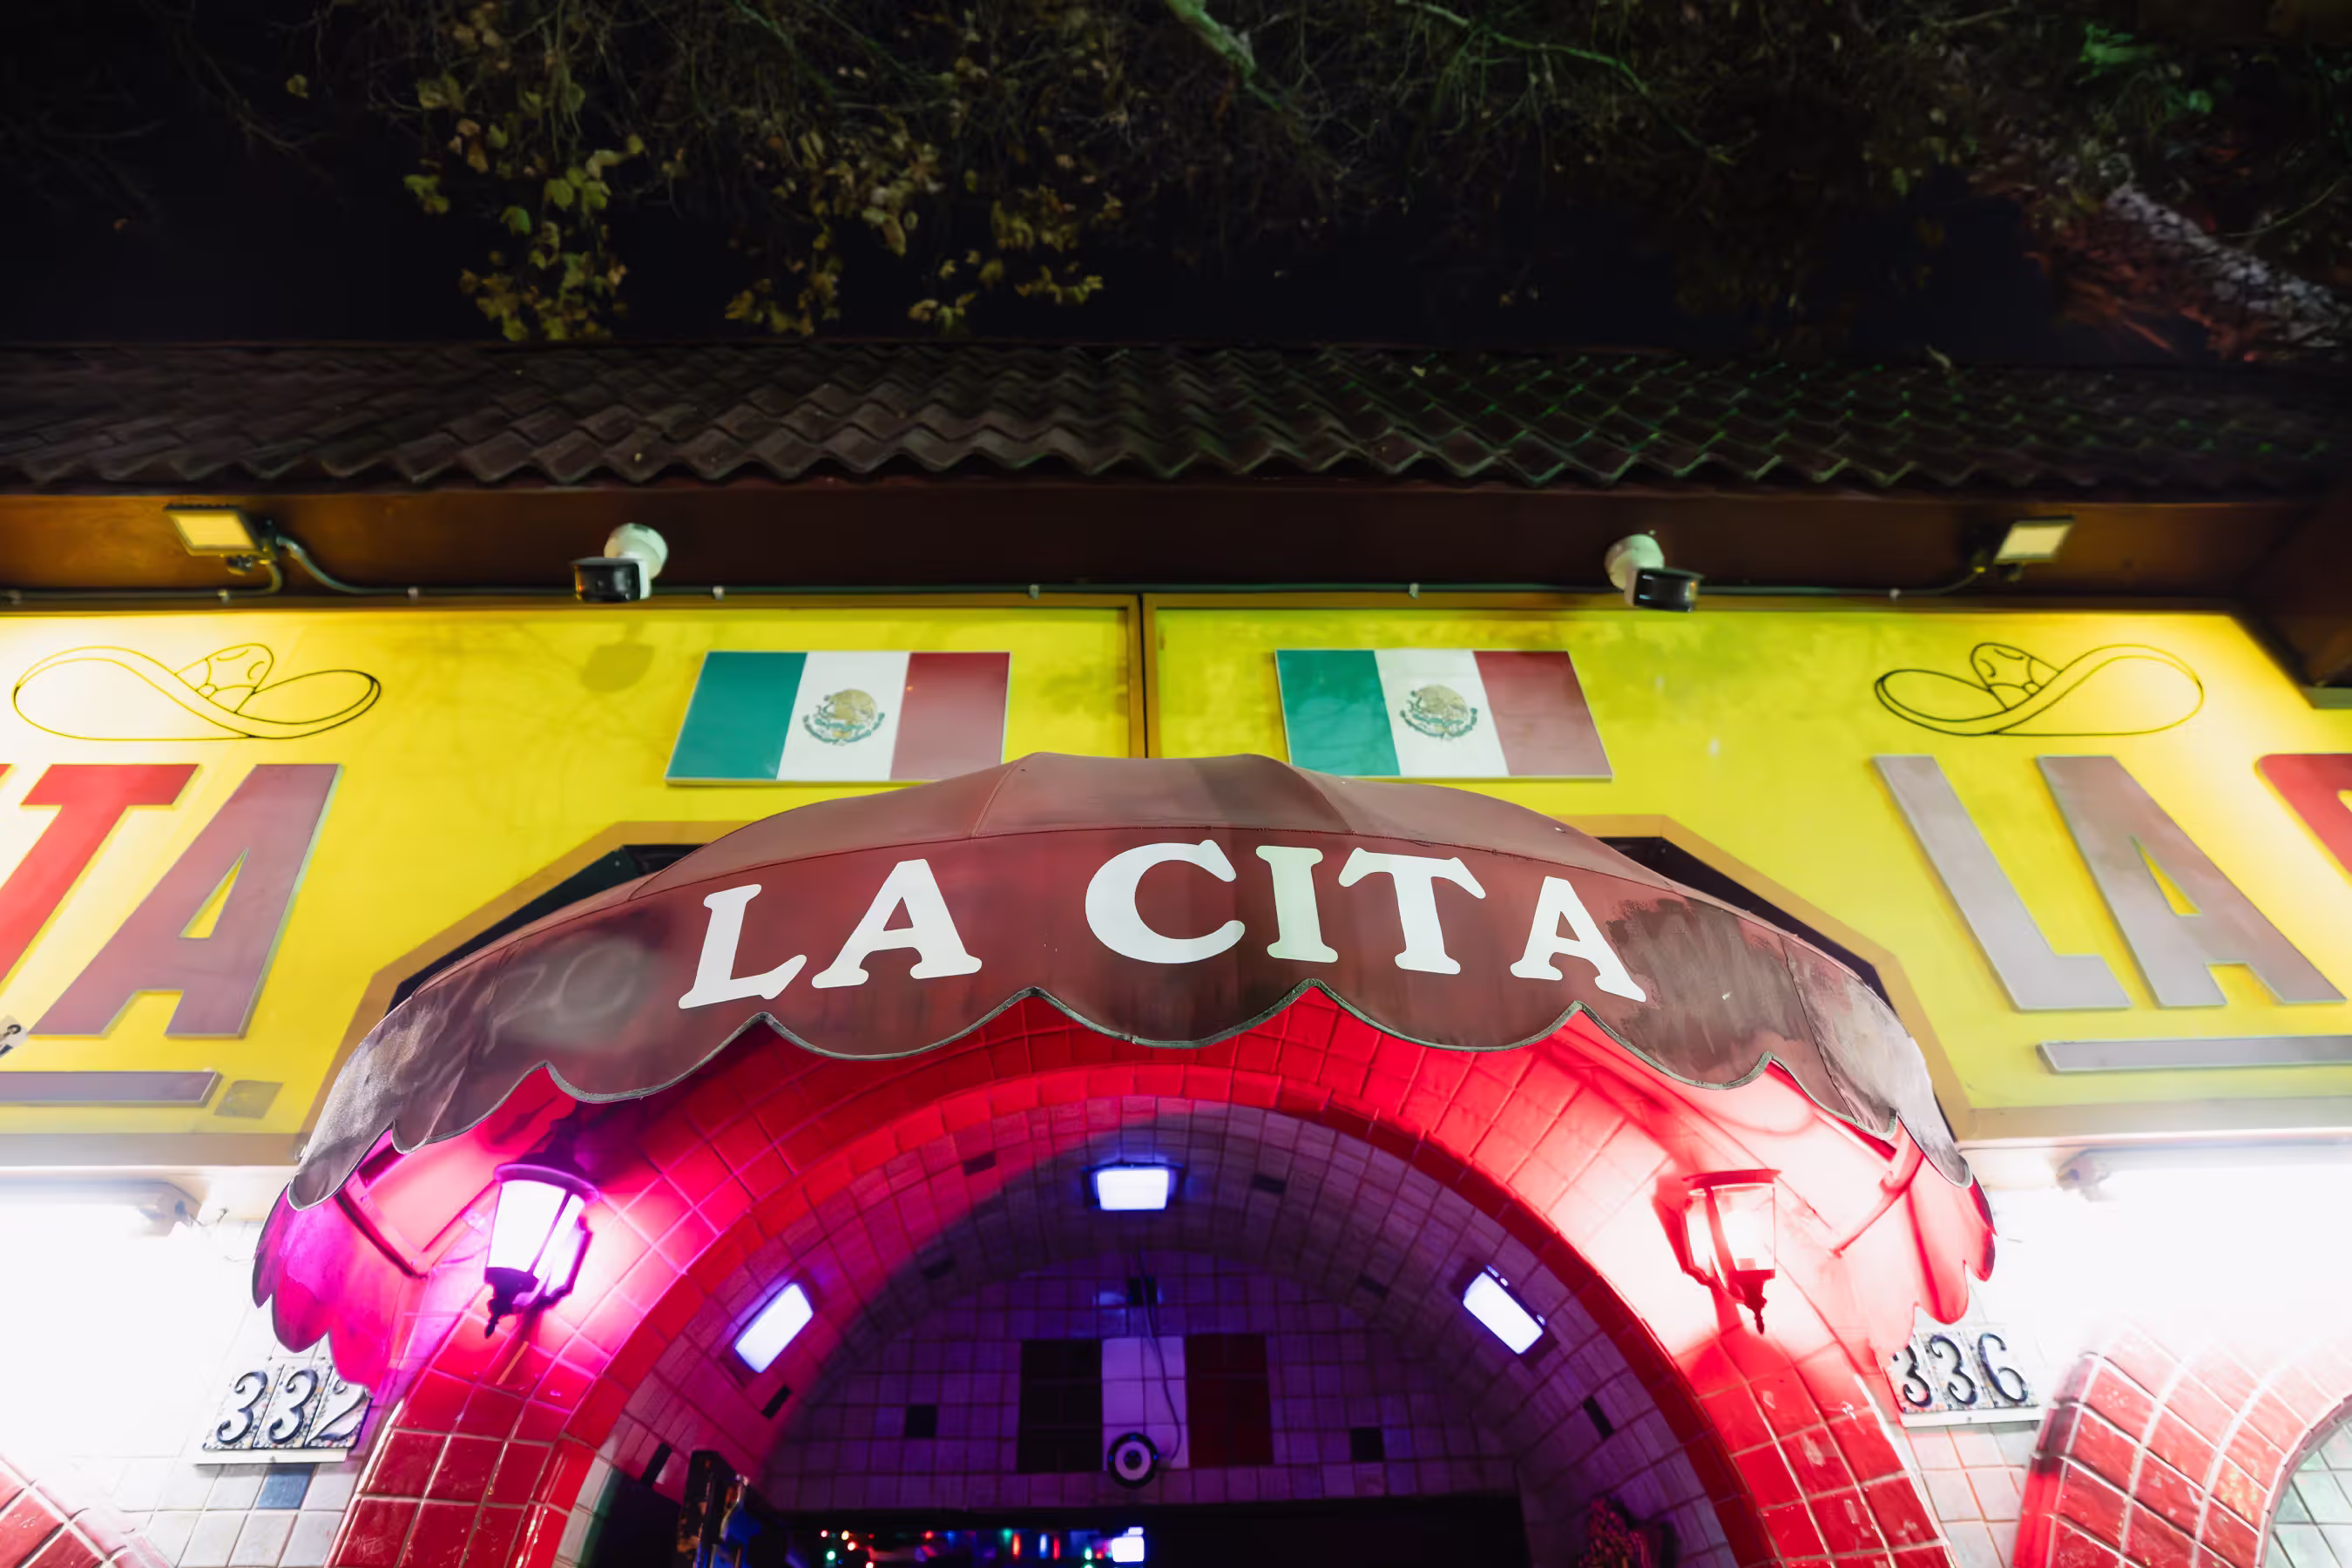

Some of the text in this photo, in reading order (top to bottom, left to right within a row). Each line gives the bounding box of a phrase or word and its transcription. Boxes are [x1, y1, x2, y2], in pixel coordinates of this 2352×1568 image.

[0, 764, 343, 1037] TA
[679, 839, 1646, 1009] LA CITA
[1871, 754, 2347, 1010] LA
[216, 1370, 368, 1445] 332
[1892, 1333, 2028, 1407] 336
